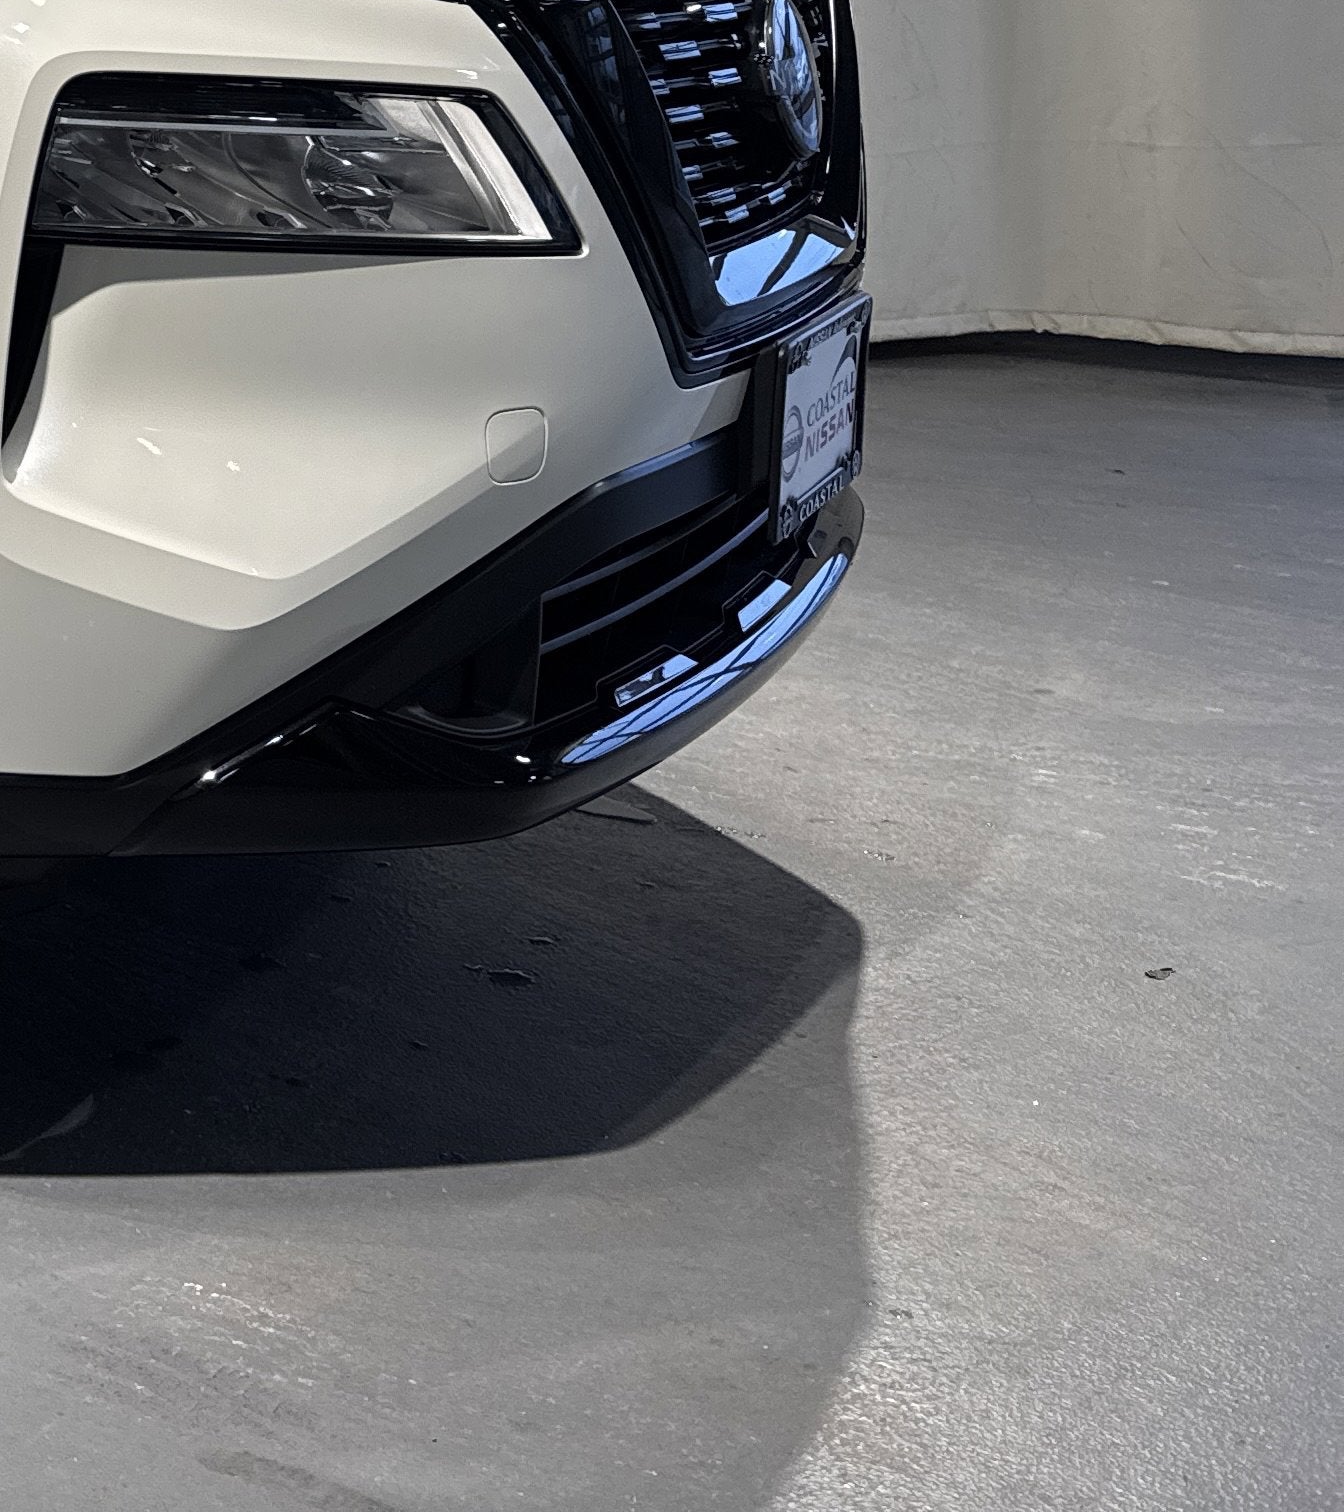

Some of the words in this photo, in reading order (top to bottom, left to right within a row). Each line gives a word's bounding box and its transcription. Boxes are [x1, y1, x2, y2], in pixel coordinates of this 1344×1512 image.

[807, 371, 855, 427] COASTAL
[804, 399, 855, 462] NISSAN
[799, 475, 844, 522] COASTAL
